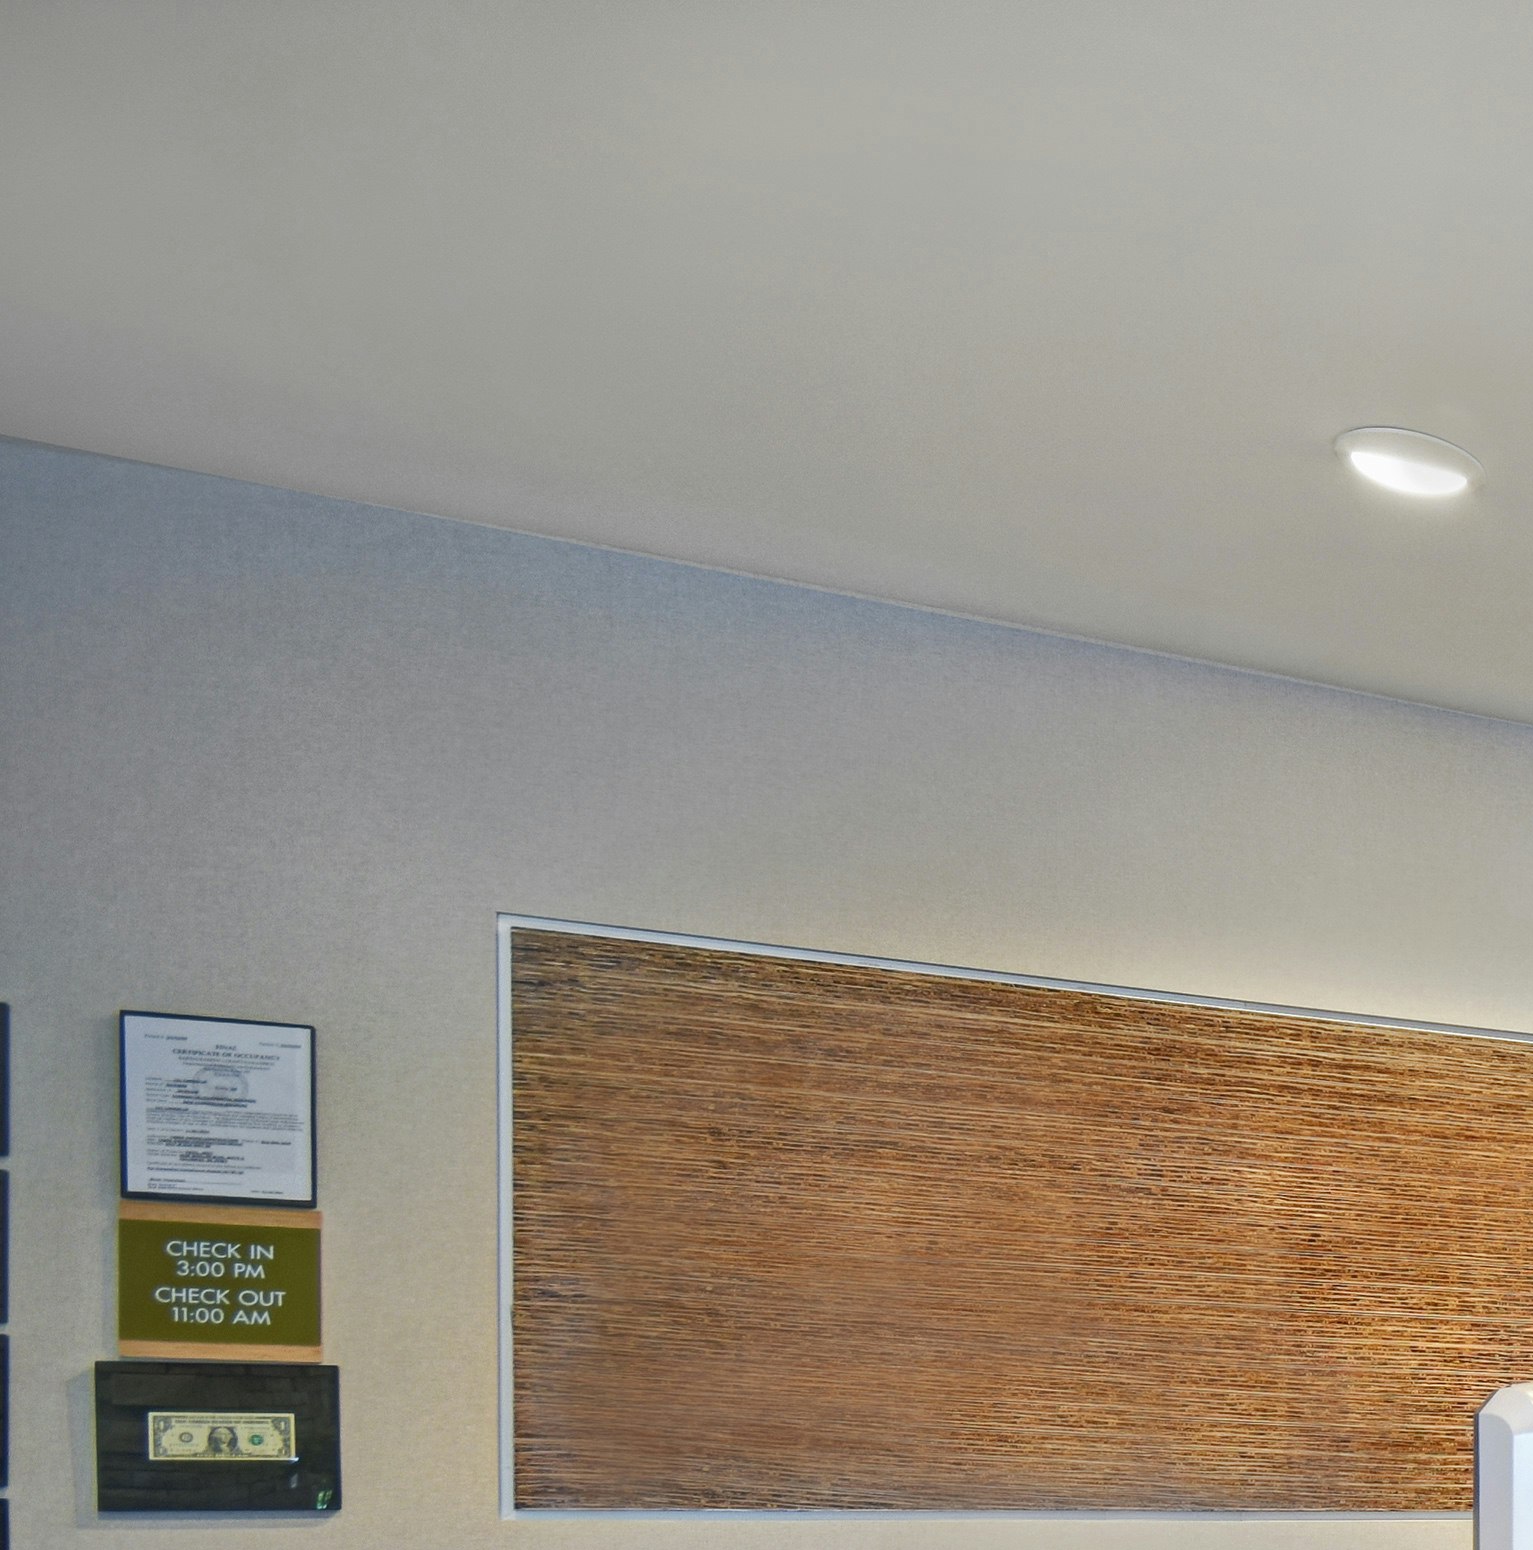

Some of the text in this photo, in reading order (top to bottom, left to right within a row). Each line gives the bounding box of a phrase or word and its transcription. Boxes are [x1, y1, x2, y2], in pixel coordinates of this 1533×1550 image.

[166, 1240, 275, 1260] CHECK IN
[177, 1260, 266, 1279] 3:00 PM
[155, 1286, 286, 1307] CHECK OUT
[172, 1307, 271, 1326] 11:00 AM
